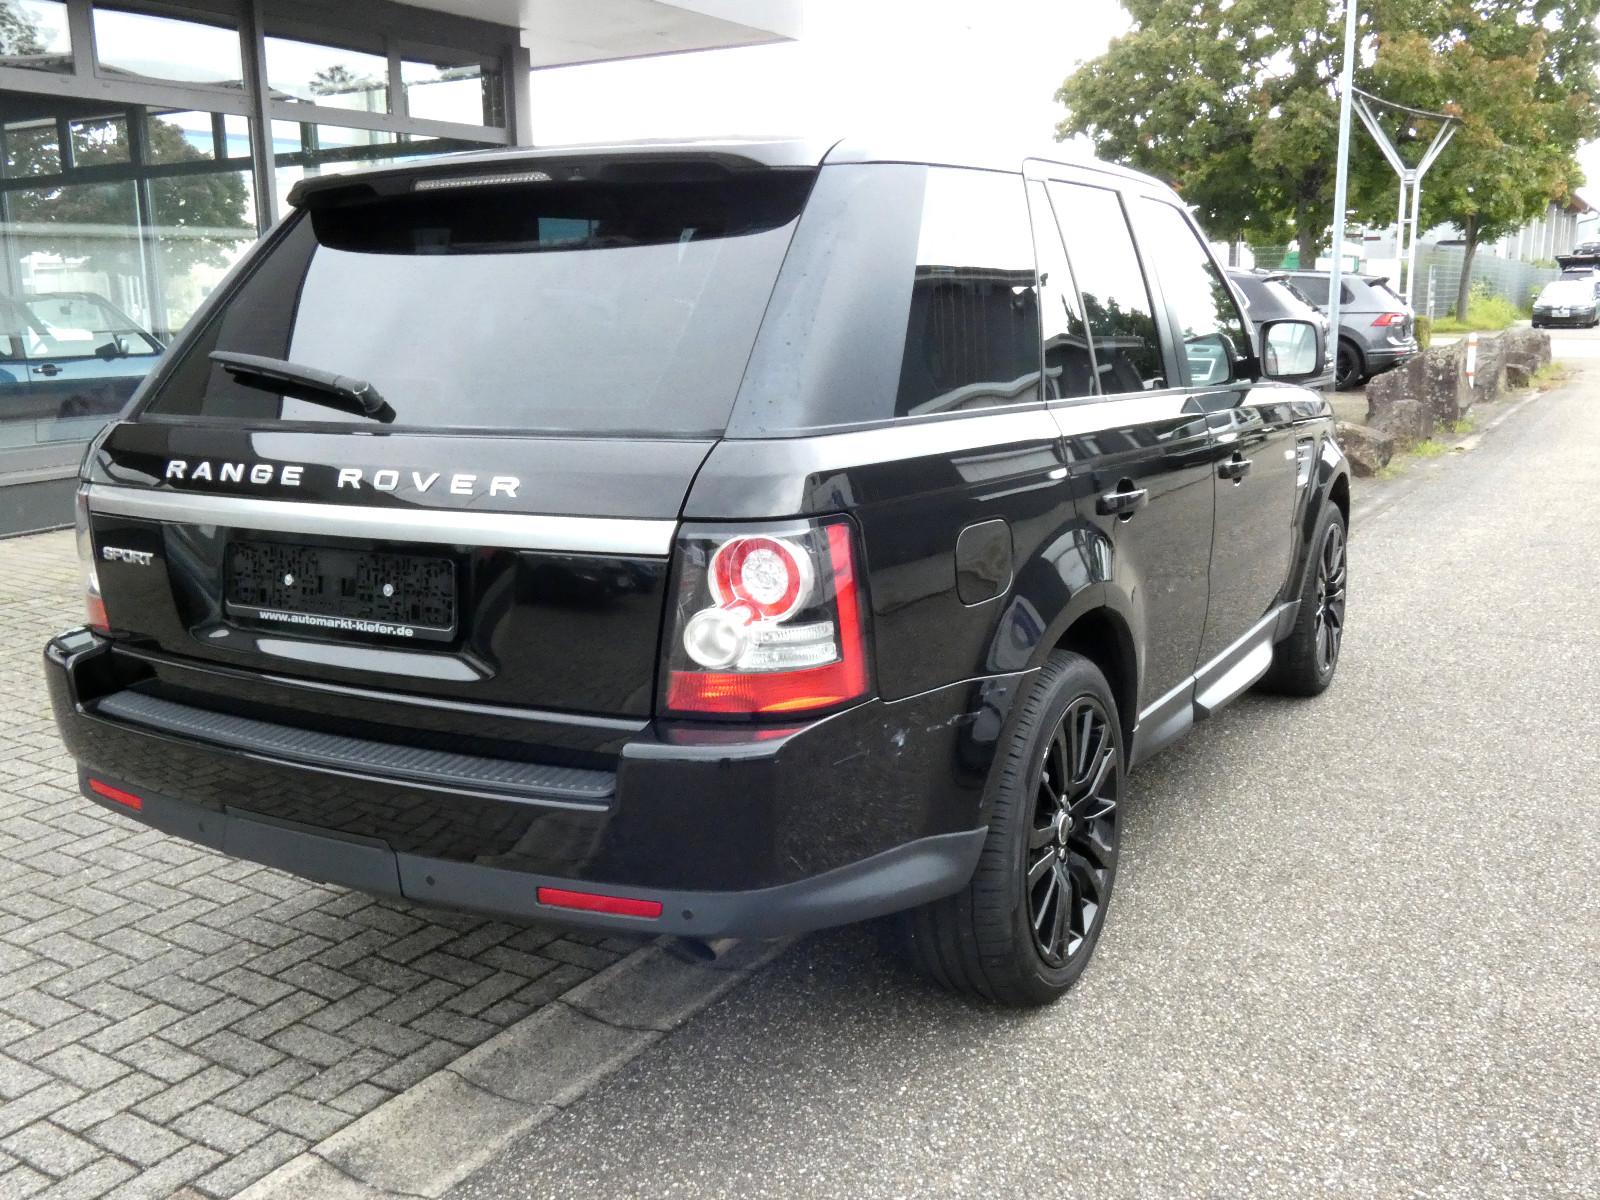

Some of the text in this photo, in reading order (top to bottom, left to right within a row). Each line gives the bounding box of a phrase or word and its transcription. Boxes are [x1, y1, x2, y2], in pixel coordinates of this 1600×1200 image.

[165, 460, 521, 498] RANGE ROVER
[102, 546, 154, 567] SPORT
[259, 611, 414, 637] www.automarkt-kiefer.de
